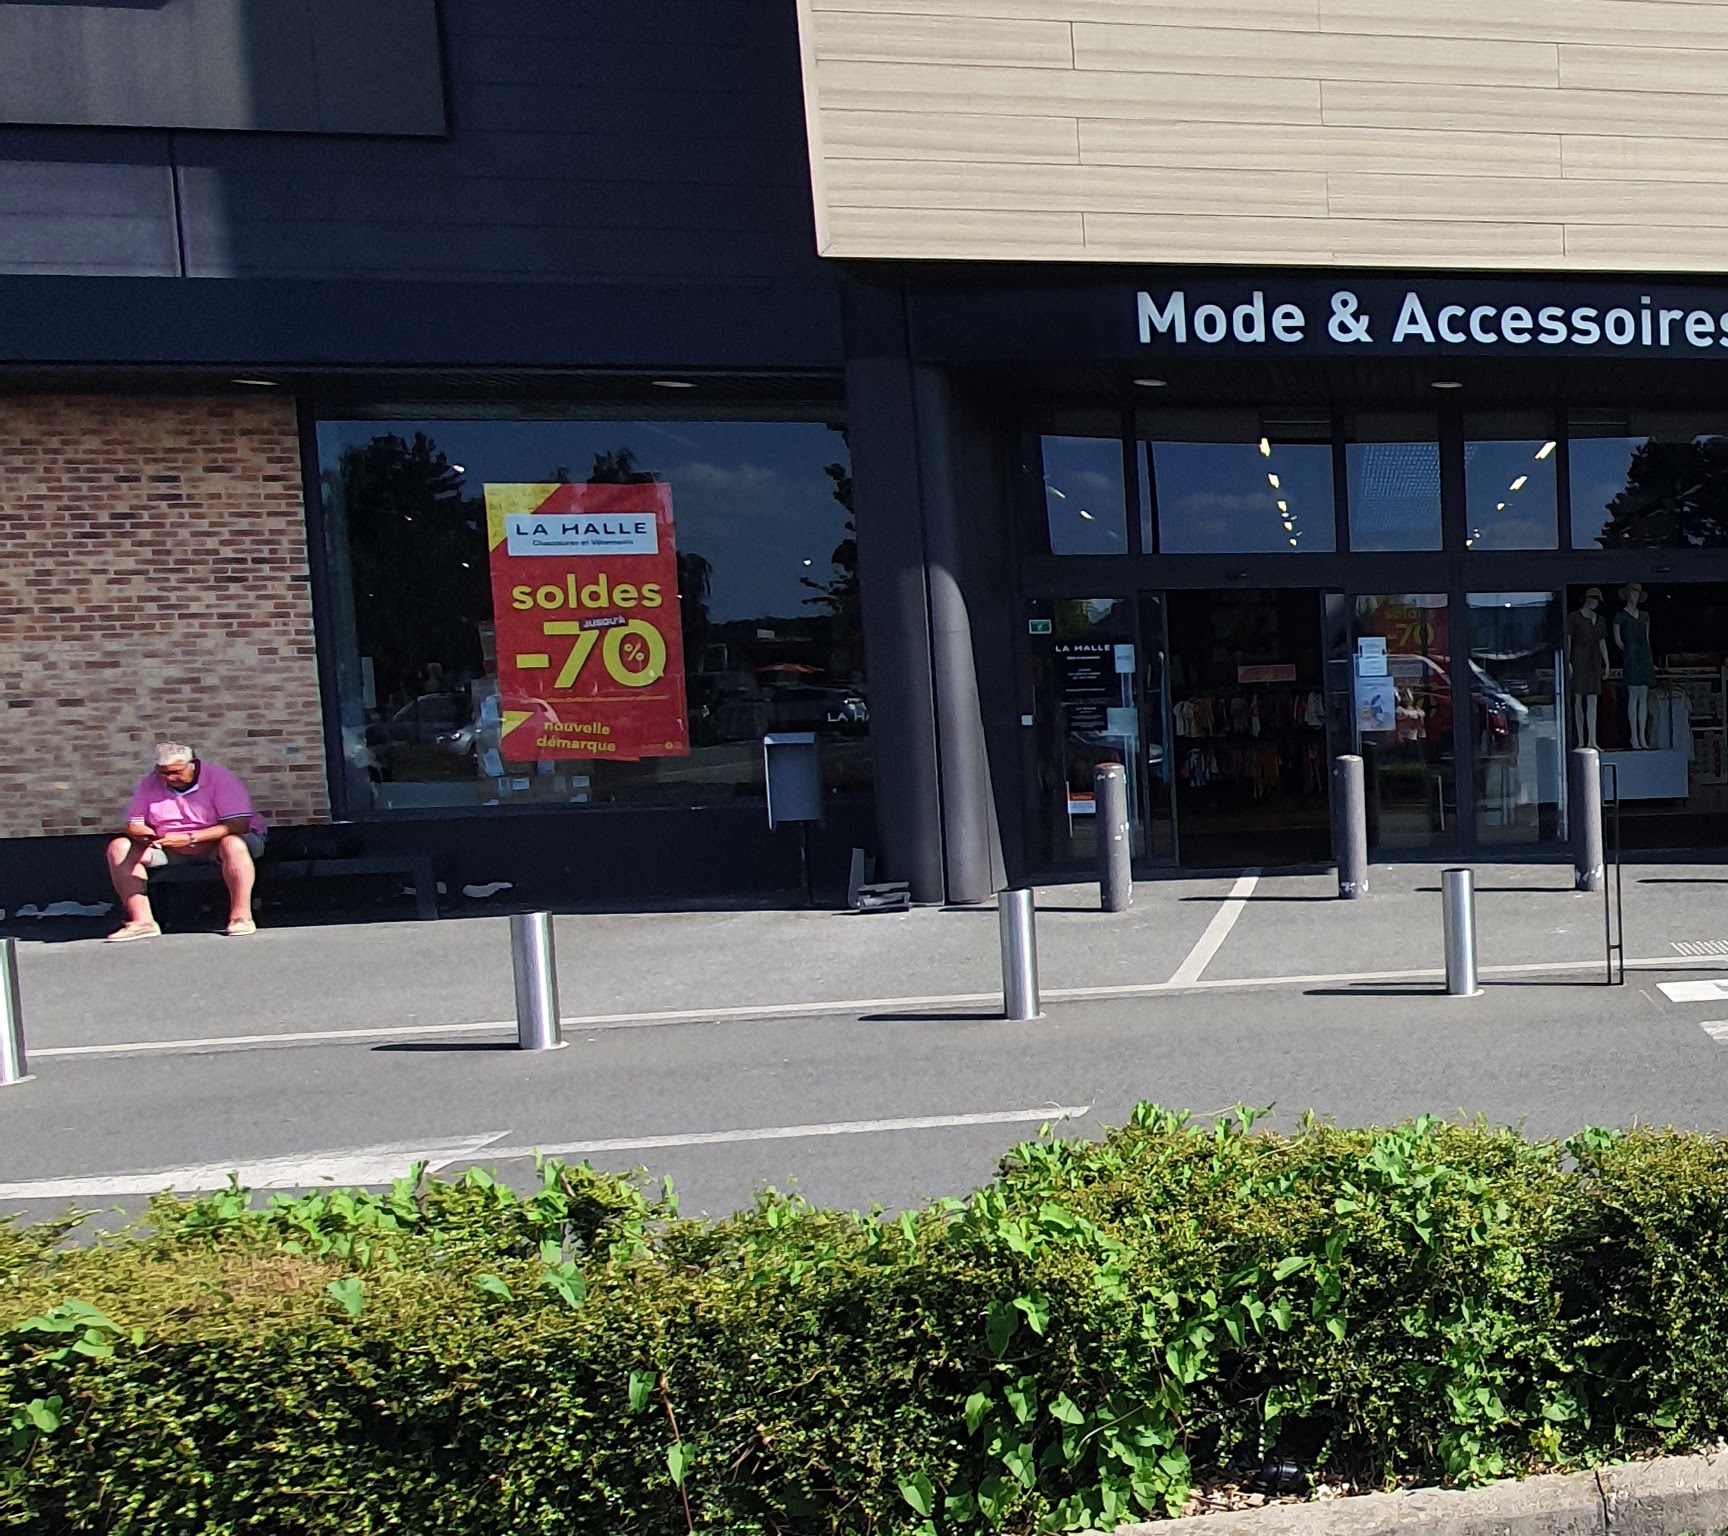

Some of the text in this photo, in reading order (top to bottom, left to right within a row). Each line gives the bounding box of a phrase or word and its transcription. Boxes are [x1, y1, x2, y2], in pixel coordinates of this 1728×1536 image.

[1136, 290, 1305, 343] Mode
[1327, 290, 1375, 343] &
[516, 522, 648, 535] LA HALLE
[511, 573, 662, 610] soldes
[1074, 644, 1110, 652] HALLE
[543, 720, 611, 735] nouvelle
[536, 734, 616, 752] démarque
